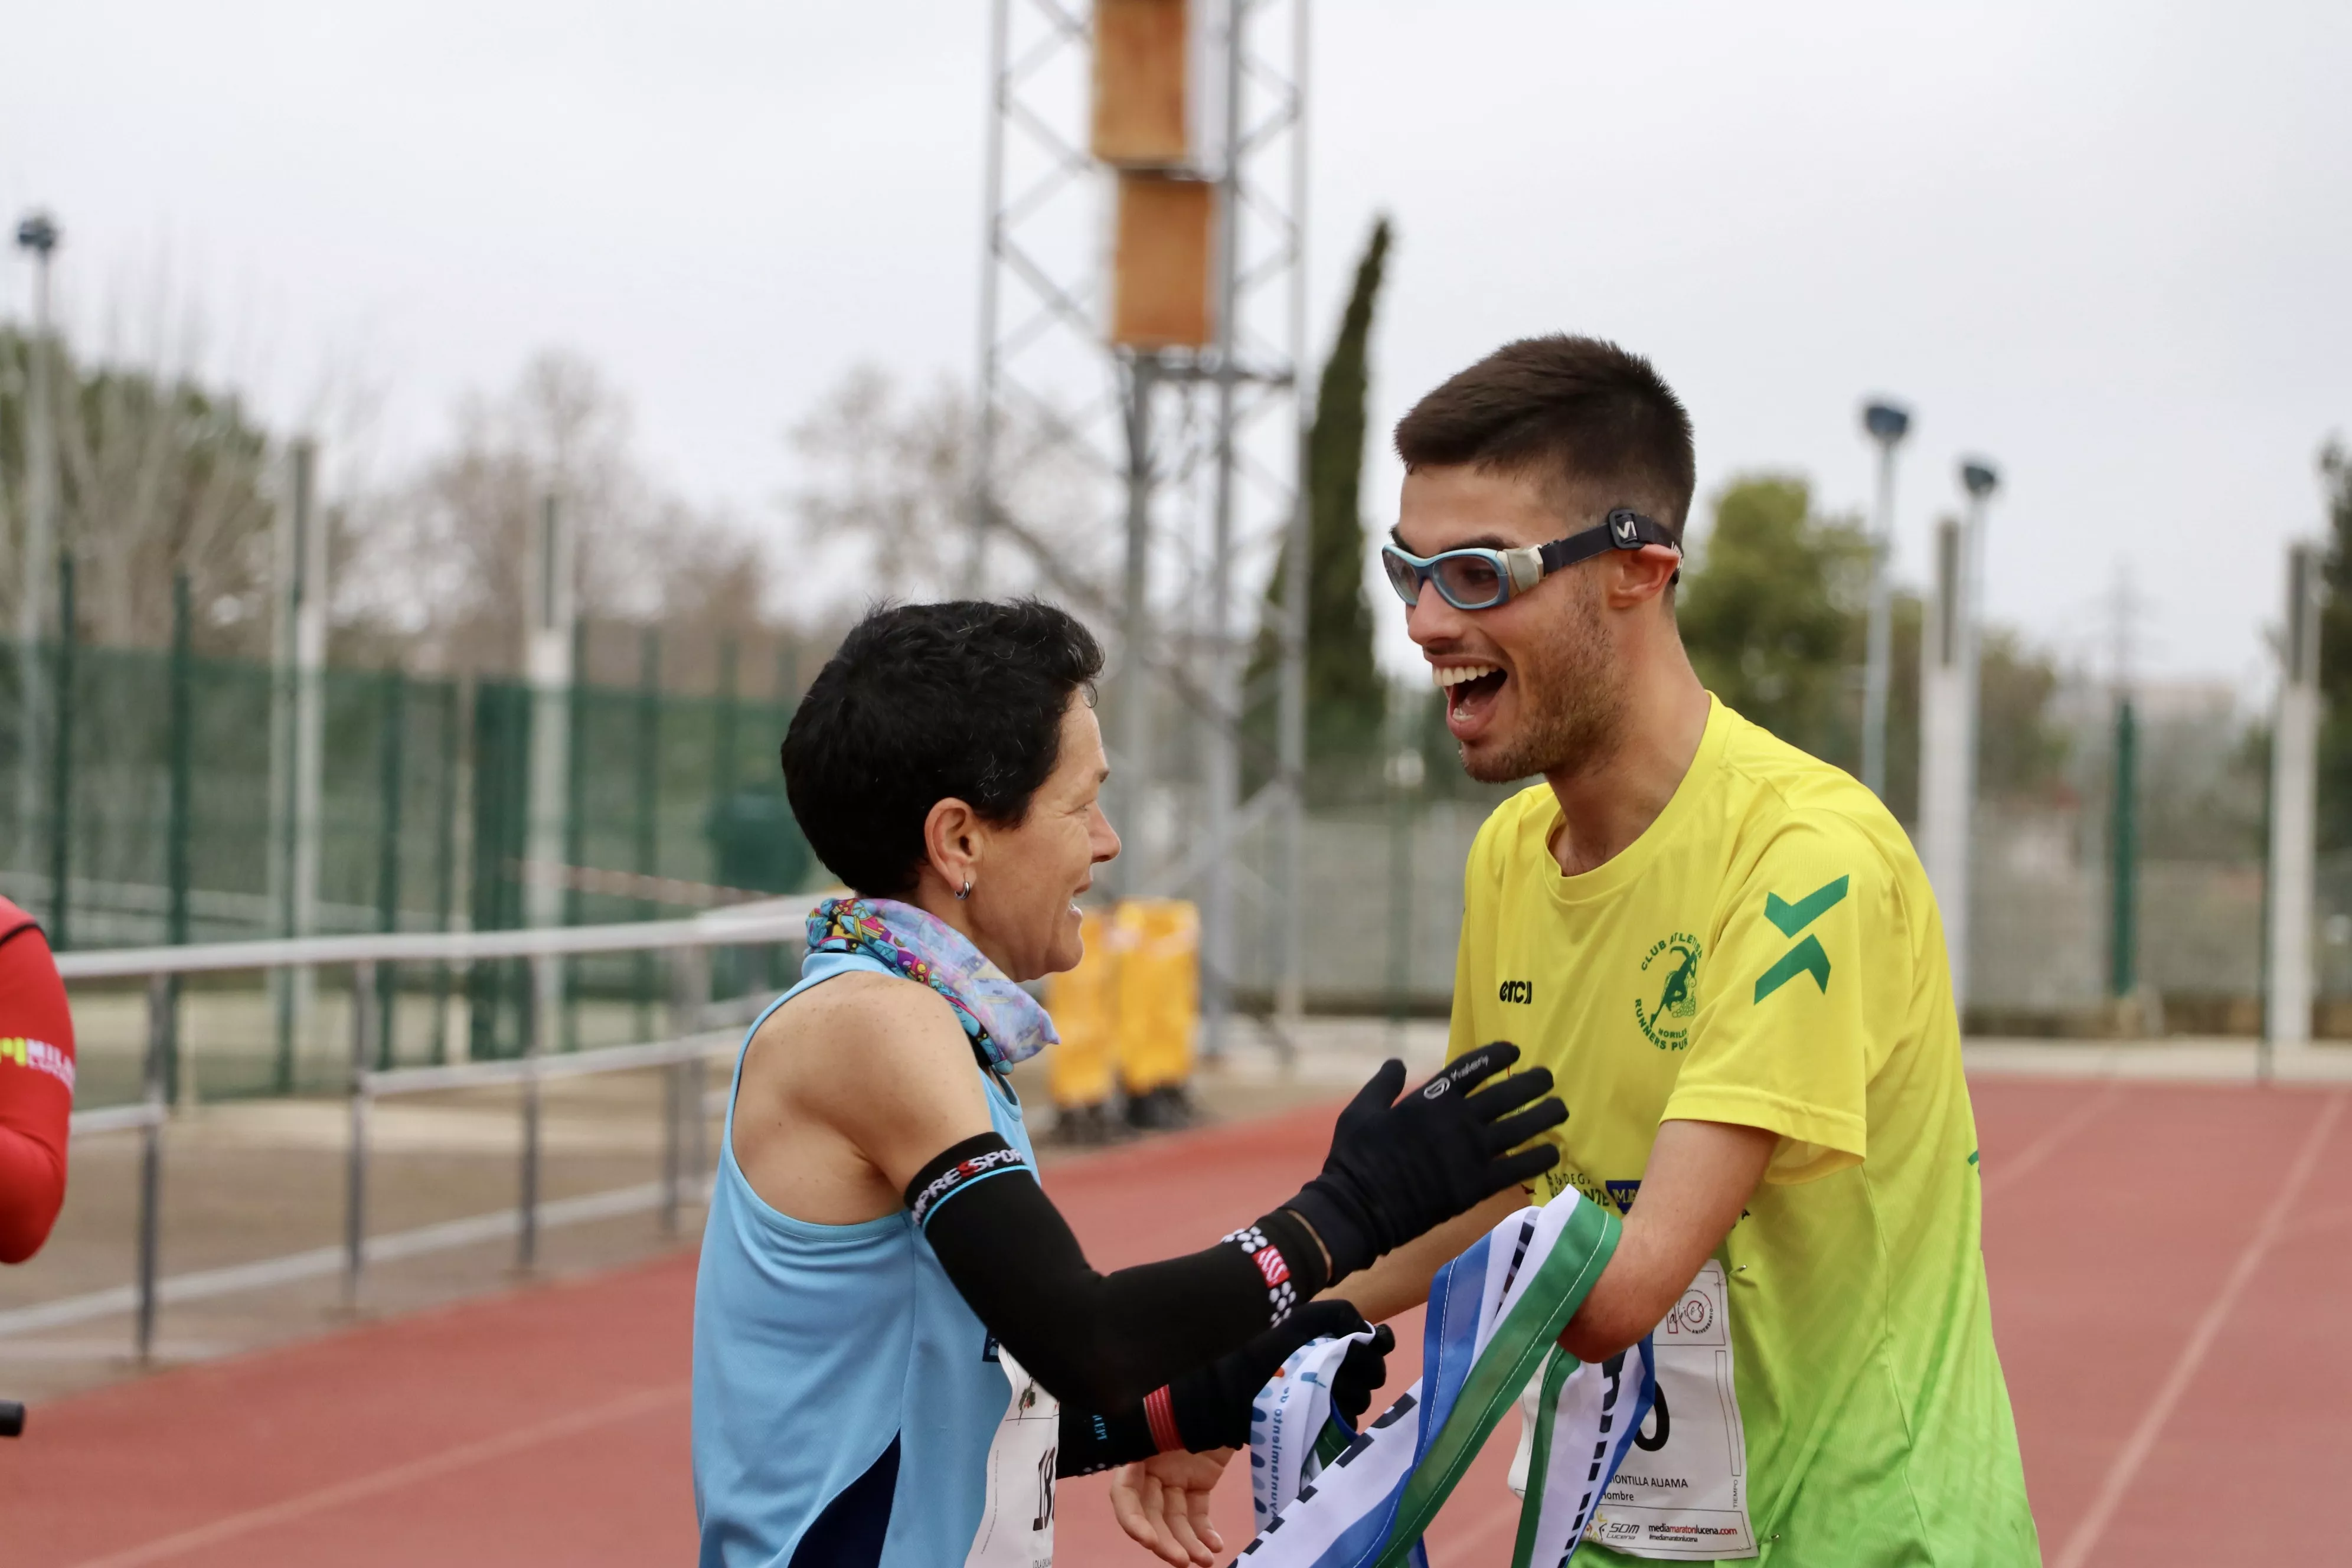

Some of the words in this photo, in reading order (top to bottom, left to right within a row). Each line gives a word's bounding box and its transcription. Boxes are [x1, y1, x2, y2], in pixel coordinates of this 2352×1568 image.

[1641, 940, 1667, 971] CLUB
[1634, 998, 1667, 1050] RUNNERS
[1671, 1037, 1688, 1051] PUR
[1658, 1027, 1689, 1039] MORILE
[1691, 1308, 1714, 1334] ANIVERSARIO
[1033, 1446, 1056, 1531] 18
[1648, 1523, 1737, 1535] mediamaratonlucena.com
[1649, 1534, 1698, 1543] #mediamaratonlucena
